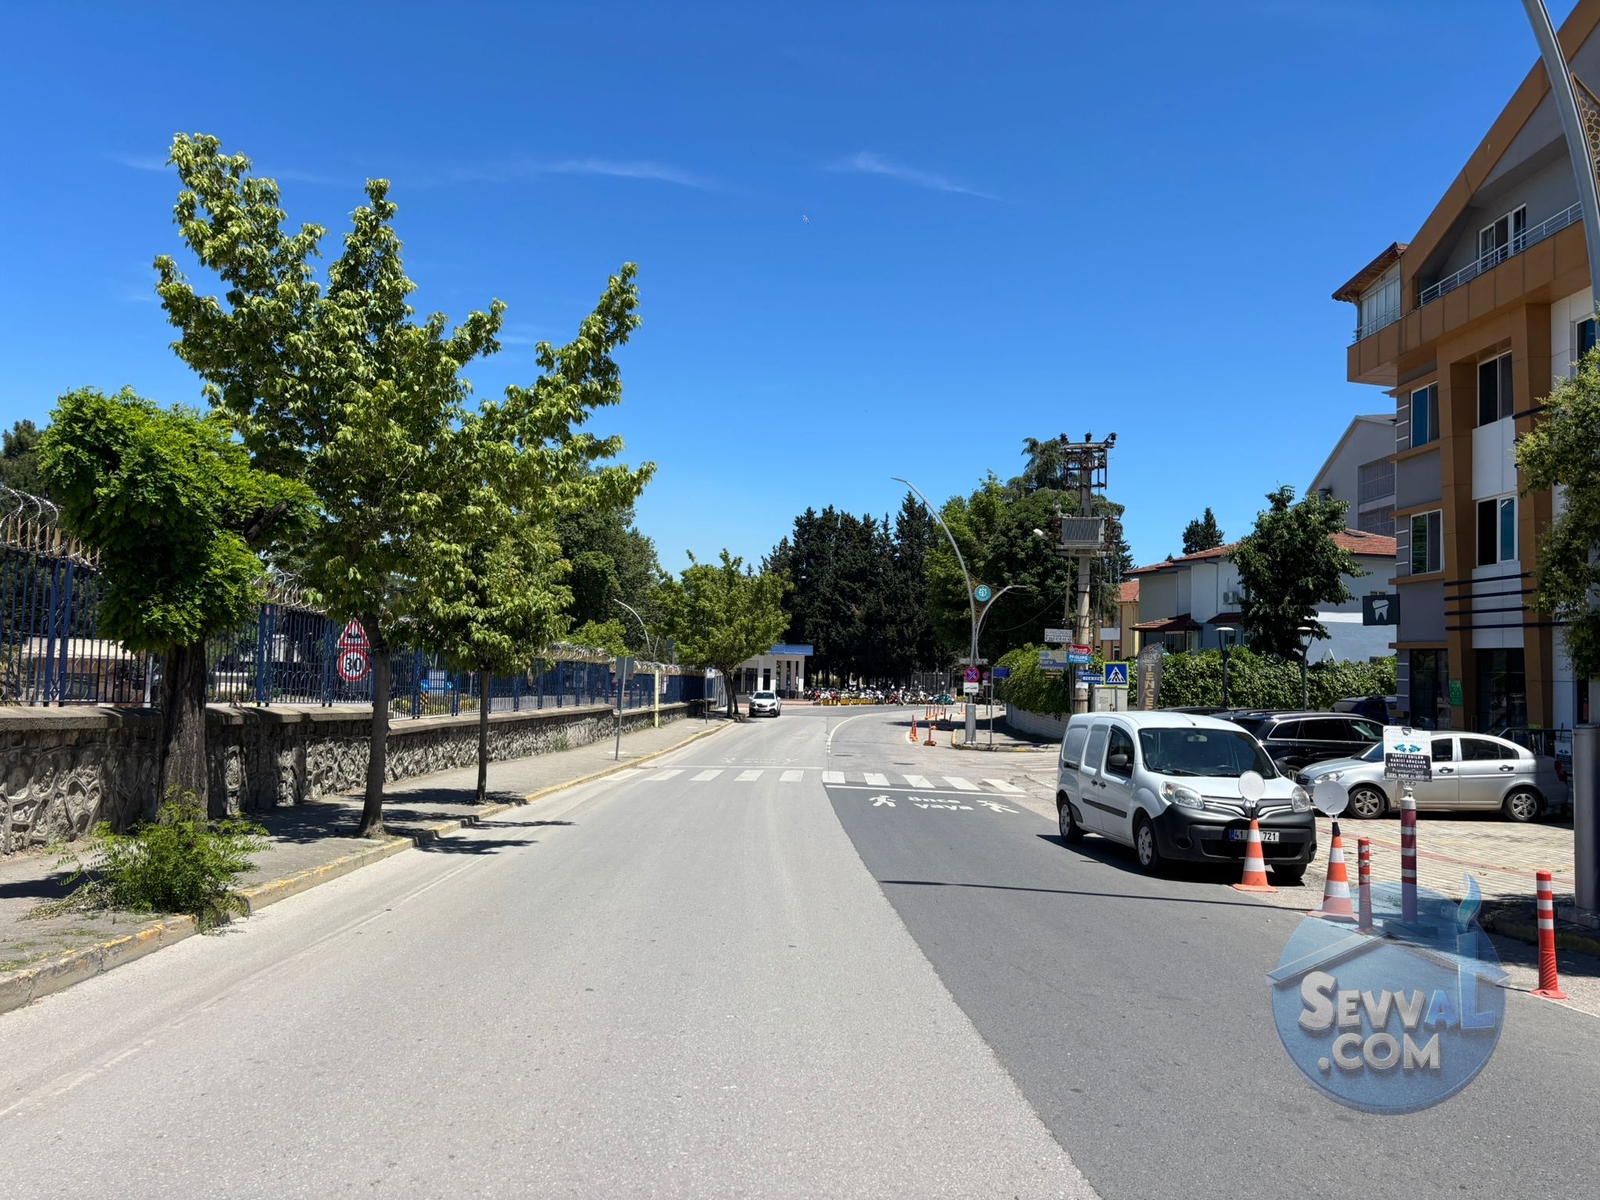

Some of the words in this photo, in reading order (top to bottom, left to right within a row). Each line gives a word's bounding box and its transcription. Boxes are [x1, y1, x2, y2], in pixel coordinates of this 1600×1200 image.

[345, 658, 362, 672] 30
[1235, 830, 1243, 839] 41
[1262, 831, 1276, 841] 721
